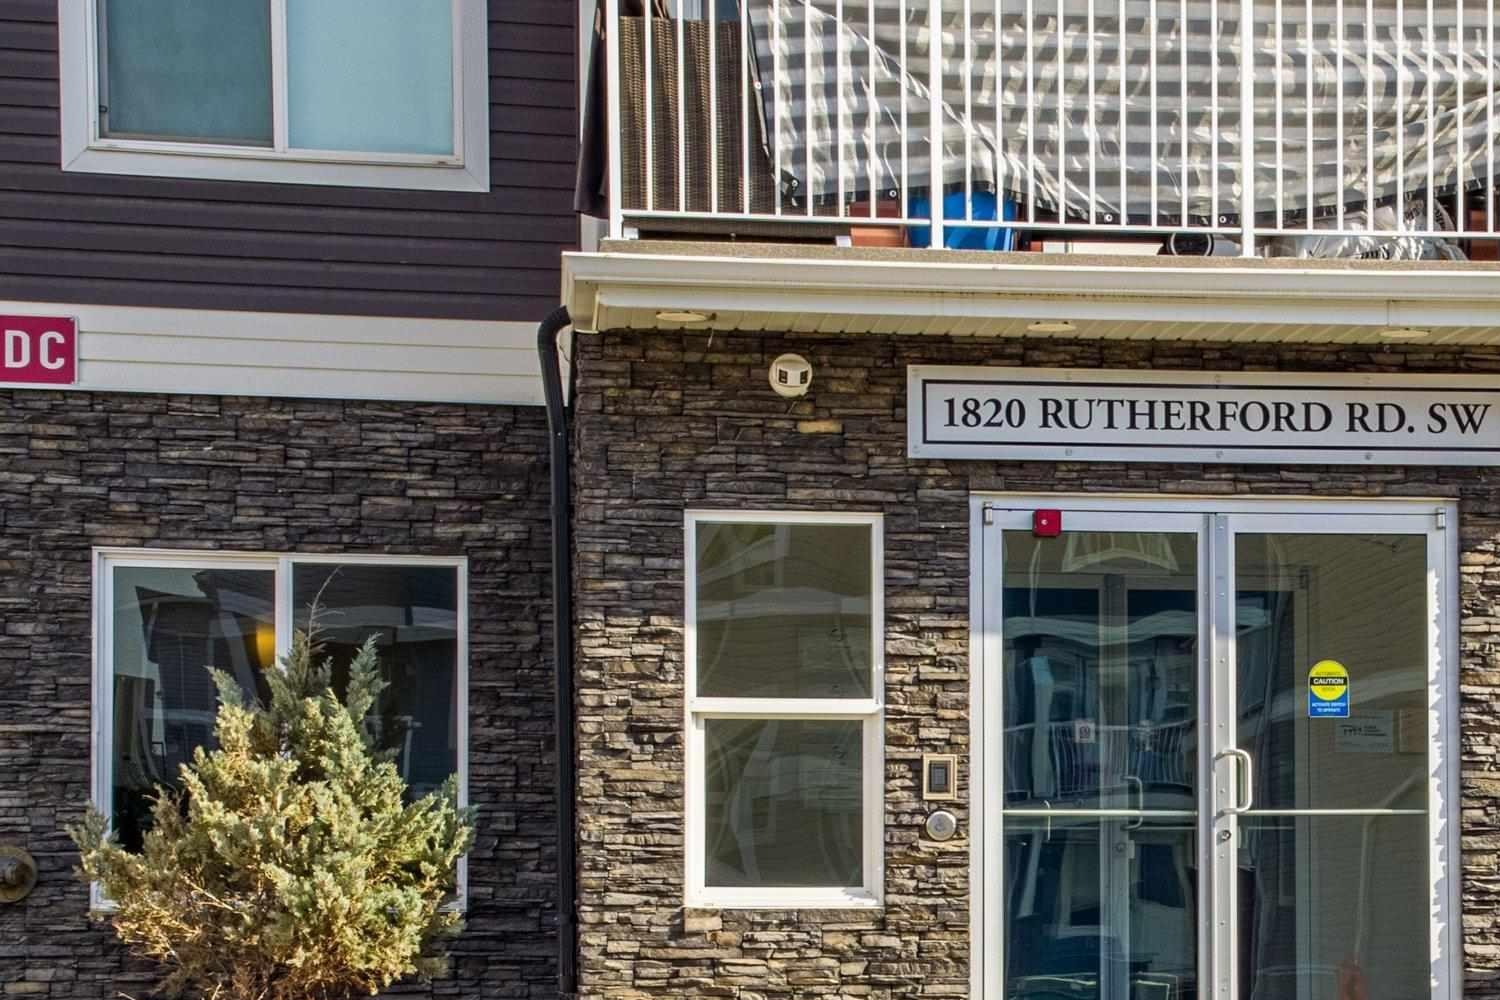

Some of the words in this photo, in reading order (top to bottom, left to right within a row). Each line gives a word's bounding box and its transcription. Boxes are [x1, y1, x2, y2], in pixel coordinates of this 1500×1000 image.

[4, 329, 65, 370] DC
[943, 397, 1026, 428] 1820
[1038, 397, 1333, 433] RUTHERFORD
[1345, 402, 1415, 433] RD.
[1427, 403, 1492, 435] SW
